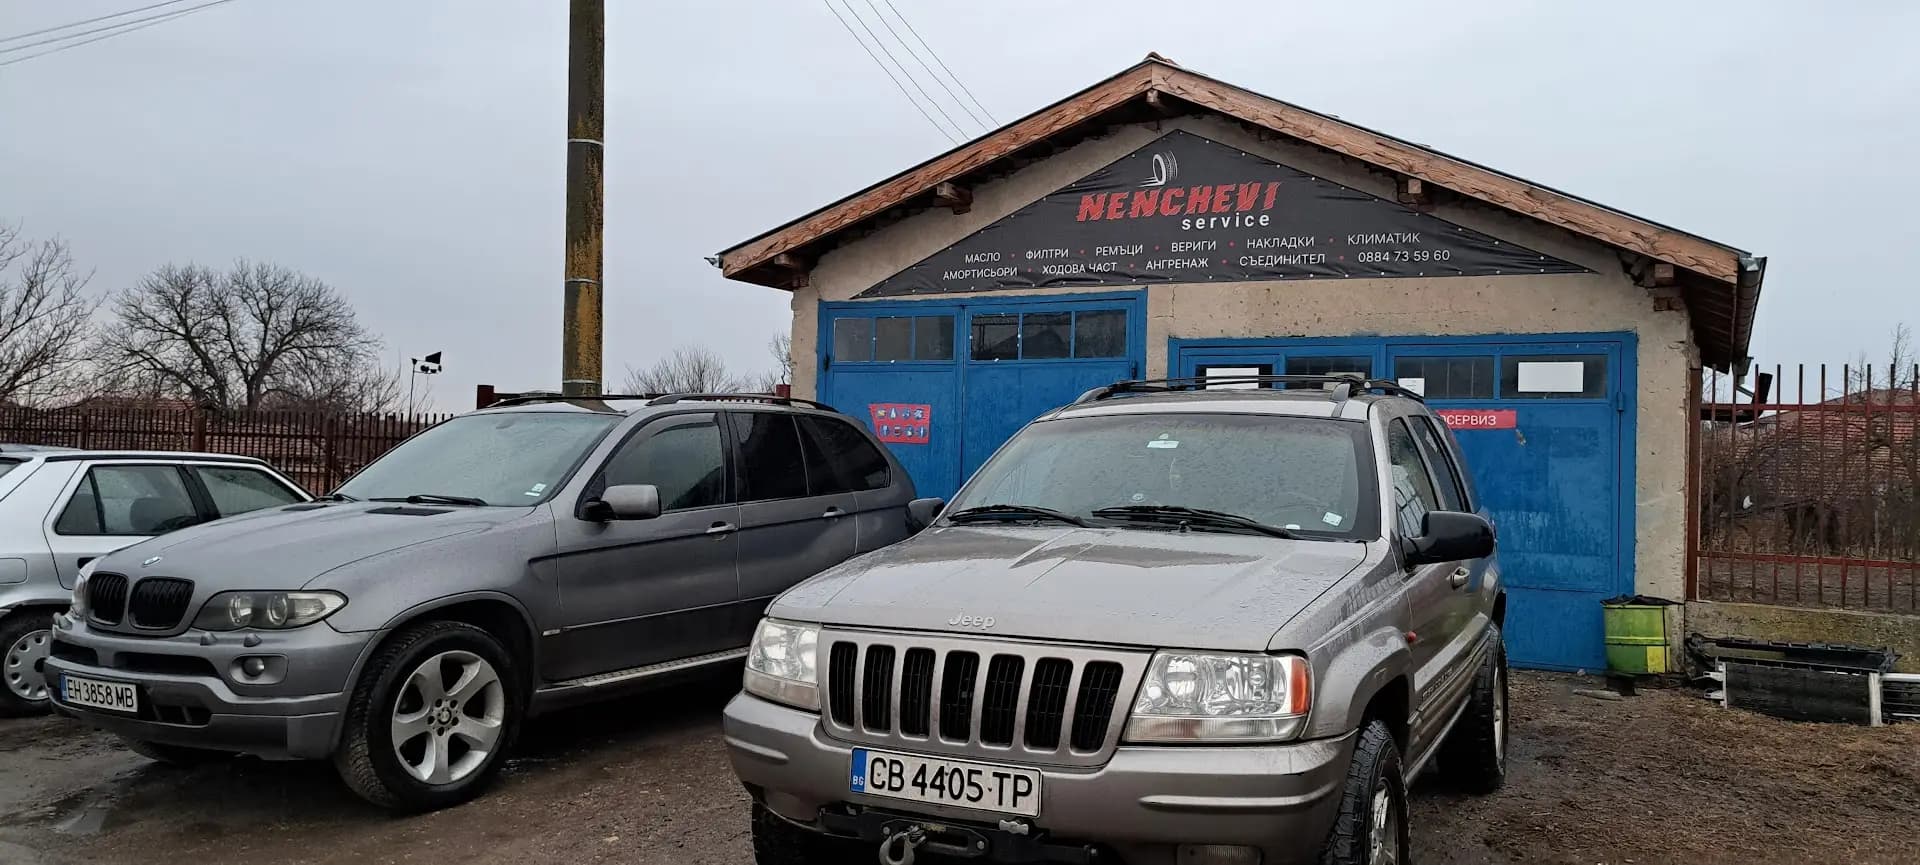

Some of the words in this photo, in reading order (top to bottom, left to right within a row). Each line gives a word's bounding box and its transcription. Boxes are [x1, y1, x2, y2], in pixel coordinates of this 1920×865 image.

[1076, 181, 1281, 222] NENCHEVI
[1181, 212, 1270, 231] service
[965, 252, 1001, 264] МАСЛО
[1025, 248, 1069, 260] ФИЛТРИ
[1095, 244, 1143, 257] РЕМЪЦИ
[1171, 240, 1216, 252] ВЕРИГИ
[1247, 236, 1315, 249] НАКЛАДКИ
[1347, 232, 1421, 245] КЛИМАТИК
[943, 267, 1017, 281] АМОРТИСЬОРИ
[1042, 263, 1086, 276] ХОДОВА
[1088, 262, 1118, 273] ЧАСТ
[1146, 258, 1209, 271] АНГРЕНАЖ
[1239, 253, 1325, 267] СЪЕДИНИТЕЛ
[1358, 251, 1389, 263] 0884
[1394, 251, 1409, 262] 73
[1413, 250, 1429, 262] 59
[1433, 250, 1450, 261] 60
[948, 609, 996, 630] Jeep
[67, 679, 82, 700] EH
[83, 682, 113, 705] 3858
[115, 686, 134, 708] MB
[852, 775, 865, 786] BG
[870, 757, 905, 792] CB
[911, 763, 984, 803] 4405
[992, 771, 1033, 808] TP
